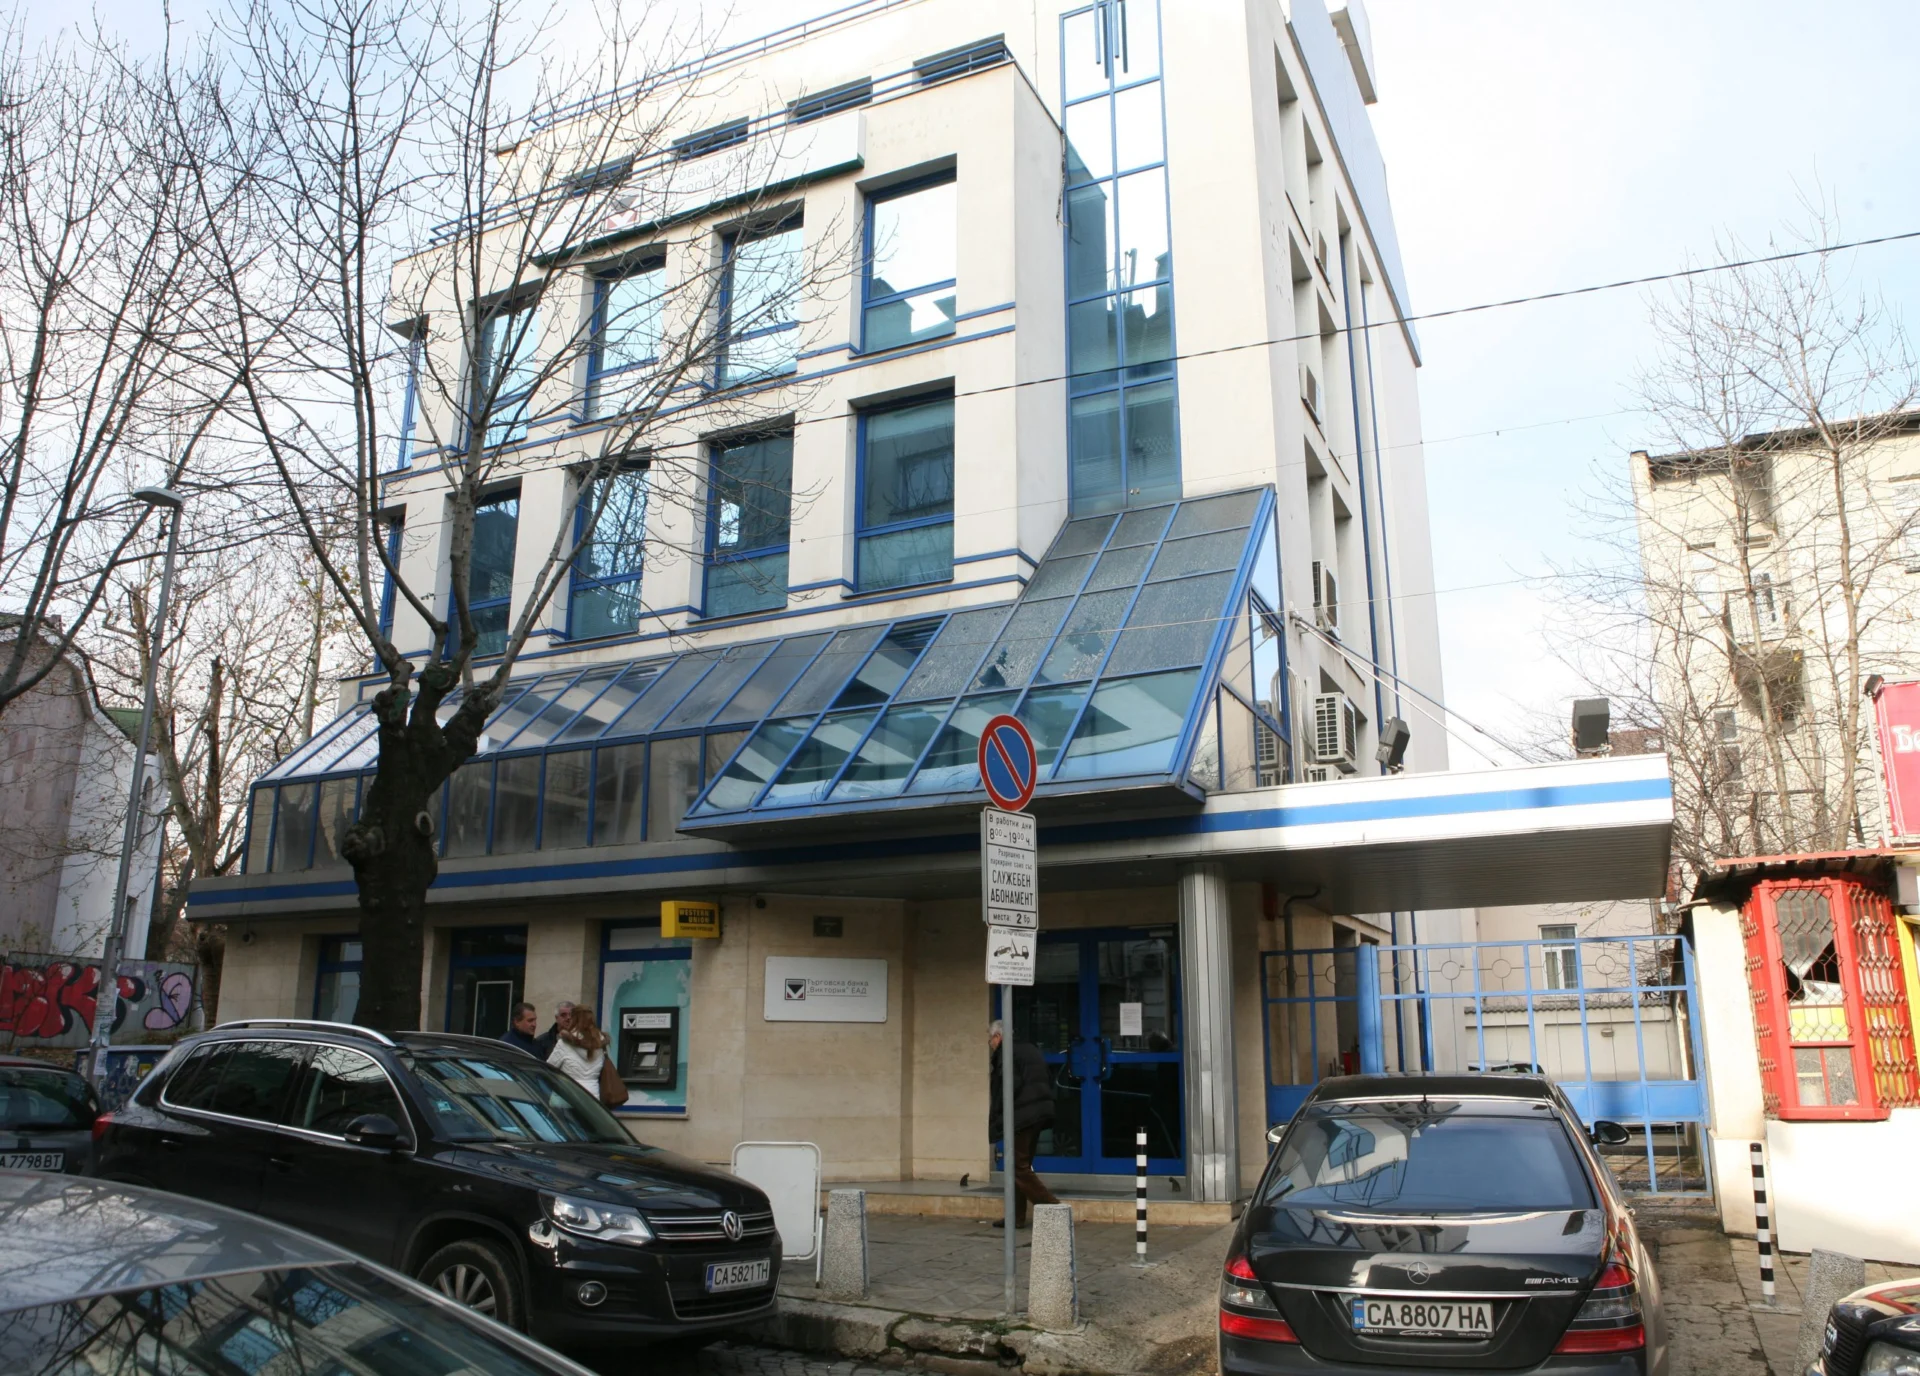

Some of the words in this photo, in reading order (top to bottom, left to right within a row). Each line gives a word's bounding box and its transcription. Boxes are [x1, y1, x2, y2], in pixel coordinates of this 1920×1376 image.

[992, 870, 1031, 887] СЛУЖЕБЕН
[991, 888, 1033, 906] АБОНАМЕНТ
[680, 909, 709, 917] WESTERN
[1016, 913, 1022, 924] 2
[807, 979, 845, 987] Търговска
[847, 979, 869, 987] банка
[851, 987, 867, 995] ЕАД
[1542, 1277, 1580, 1285] AMG
